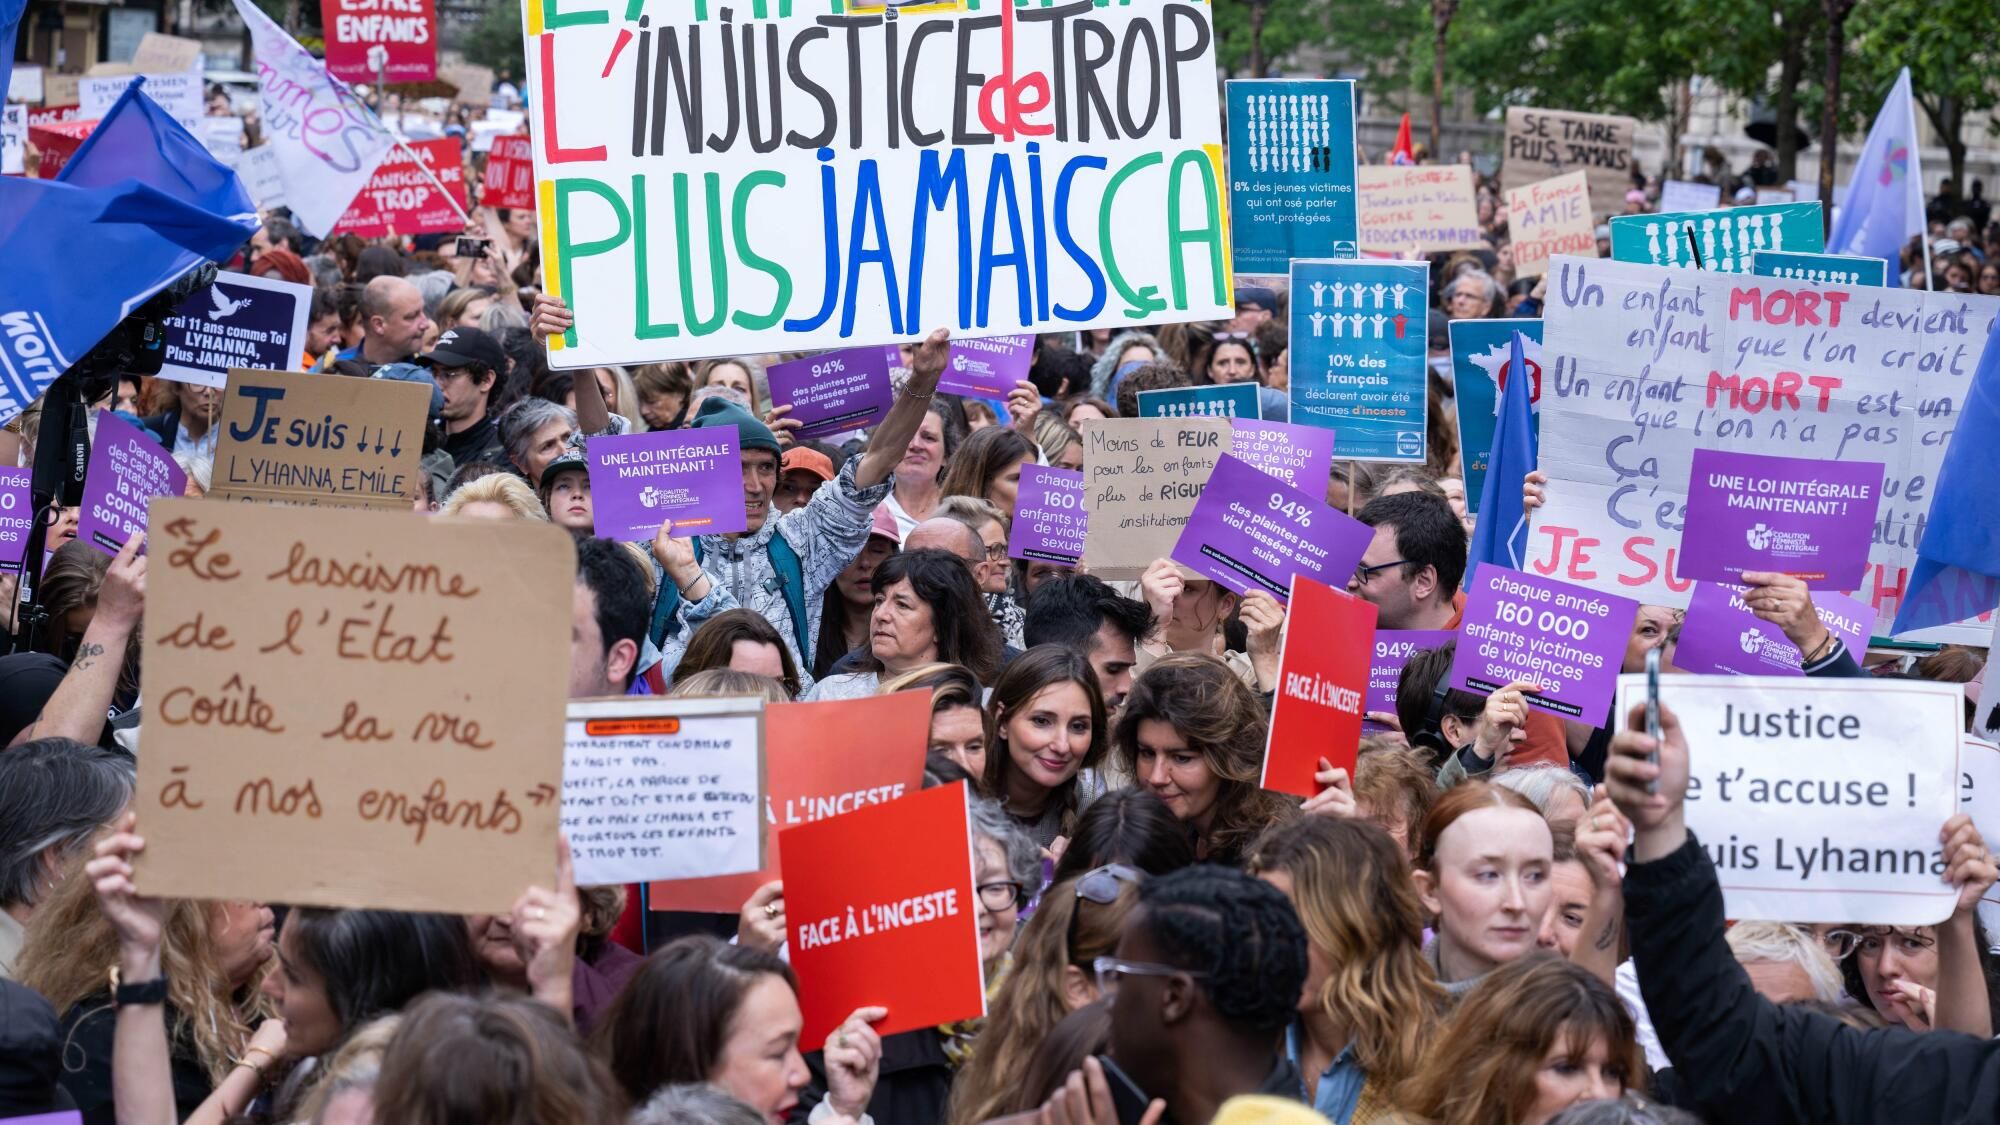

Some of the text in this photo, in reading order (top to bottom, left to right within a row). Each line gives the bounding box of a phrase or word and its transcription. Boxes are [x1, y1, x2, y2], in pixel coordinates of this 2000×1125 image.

[336, 15, 429, 44] ENFANTS
[978, 0, 1056, 143] de
[1015, 1, 1211, 144] TROP
[1522, 113, 1621, 144] SE TAIRE
[1510, 135, 1630, 170] PLUS JAMAIS
[1234, 181, 1352, 195] 8% des jeunes victimes
[1246, 196, 1337, 210] qui ont osé parler
[1253, 212, 1331, 225] sont protégées
[1522, 195, 1582, 229] AMIE
[556, 141, 1229, 349] PLUS JAMAIS ÇA
[1560, 263, 1969, 336] Un enfant MORT devient
[163, 316, 287, 345] J'ai 11 ans comme Toi
[185, 331, 260, 360] LYHANNA,
[166, 345, 248, 369] Plus JAMAIS
[1329, 354, 1387, 368] 10% des
[1627, 321, 1974, 376] enfant que l'on croit
[811, 359, 845, 378] 94%
[1326, 370, 1389, 388] français
[792, 373, 867, 397] des plaintes pour
[793, 383, 870, 407] viol classées sans
[1305, 388, 1410, 402] déclarent avoir été
[1553, 355, 1952, 418] Un enfant MORT est un
[823, 398, 845, 410] suite
[1305, 404, 1406, 416] victimes d'inceste
[286, 415, 348, 449] SUIS
[1091, 429, 1219, 455] Moins de PEUR
[1259, 430, 1289, 444] 90%
[1633, 407, 1899, 460] que l'on n'a pas
[75, 443, 84, 481] Canon
[108, 443, 147, 477] des cas
[129, 439, 169, 480] Dans 90%
[601, 444, 730, 466] UNE LOI INTÉGRALE
[1252, 440, 1312, 458] de viol ou
[1264, 452, 1306, 469] de viol,
[1605, 435, 1660, 483] Ça
[111, 459, 153, 493] tentative
[229, 455, 406, 497] LYHANNA, EMILE,
[619, 460, 707, 478] MAINTENANT
[1036, 472, 1085, 490] chaque
[1093, 455, 1214, 483] pour les enfants
[117, 475, 129, 496] la
[1043, 491, 1075, 509] 160
[1097, 485, 1153, 510] plus de
[1709, 473, 1744, 490] UNE
[1748, 478, 1776, 494] LOI
[1779, 480, 1870, 500] INTÉGRALE
[93, 505, 120, 528] son
[1020, 508, 1071, 525] enfants
[1268, 493, 1313, 528] 94%
[1606, 484, 1687, 531] C'es
[1727, 494, 1839, 515] MAINTENANT
[1033, 521, 1051, 534] de
[1222, 513, 1323, 572] viol classées sans
[1229, 501, 1328, 559] des plaintes pour
[1252, 545, 1281, 567] suite
[1533, 526, 1693, 593] JE SU
[1489, 575, 1609, 617] chaque année
[157, 612, 235, 651] de
[1495, 600, 1589, 641] 160 000
[1376, 641, 1418, 658] 94%
[1466, 623, 1604, 668] enfants victimes
[1479, 642, 1584, 681] de violences
[1286, 671, 1312, 701] FACE
[1486, 663, 1561, 693] sexuelles
[322, 700, 393, 741] la
[412, 694, 495, 750] vie
[1718, 703, 1862, 740] Justice
[235, 777, 323, 818] nos
[1715, 767, 1916, 807] t'accuse !
[1705, 837, 1949, 880] uis Lyhanna
[799, 916, 842, 950] FACE
[845, 905, 860, 939] À
